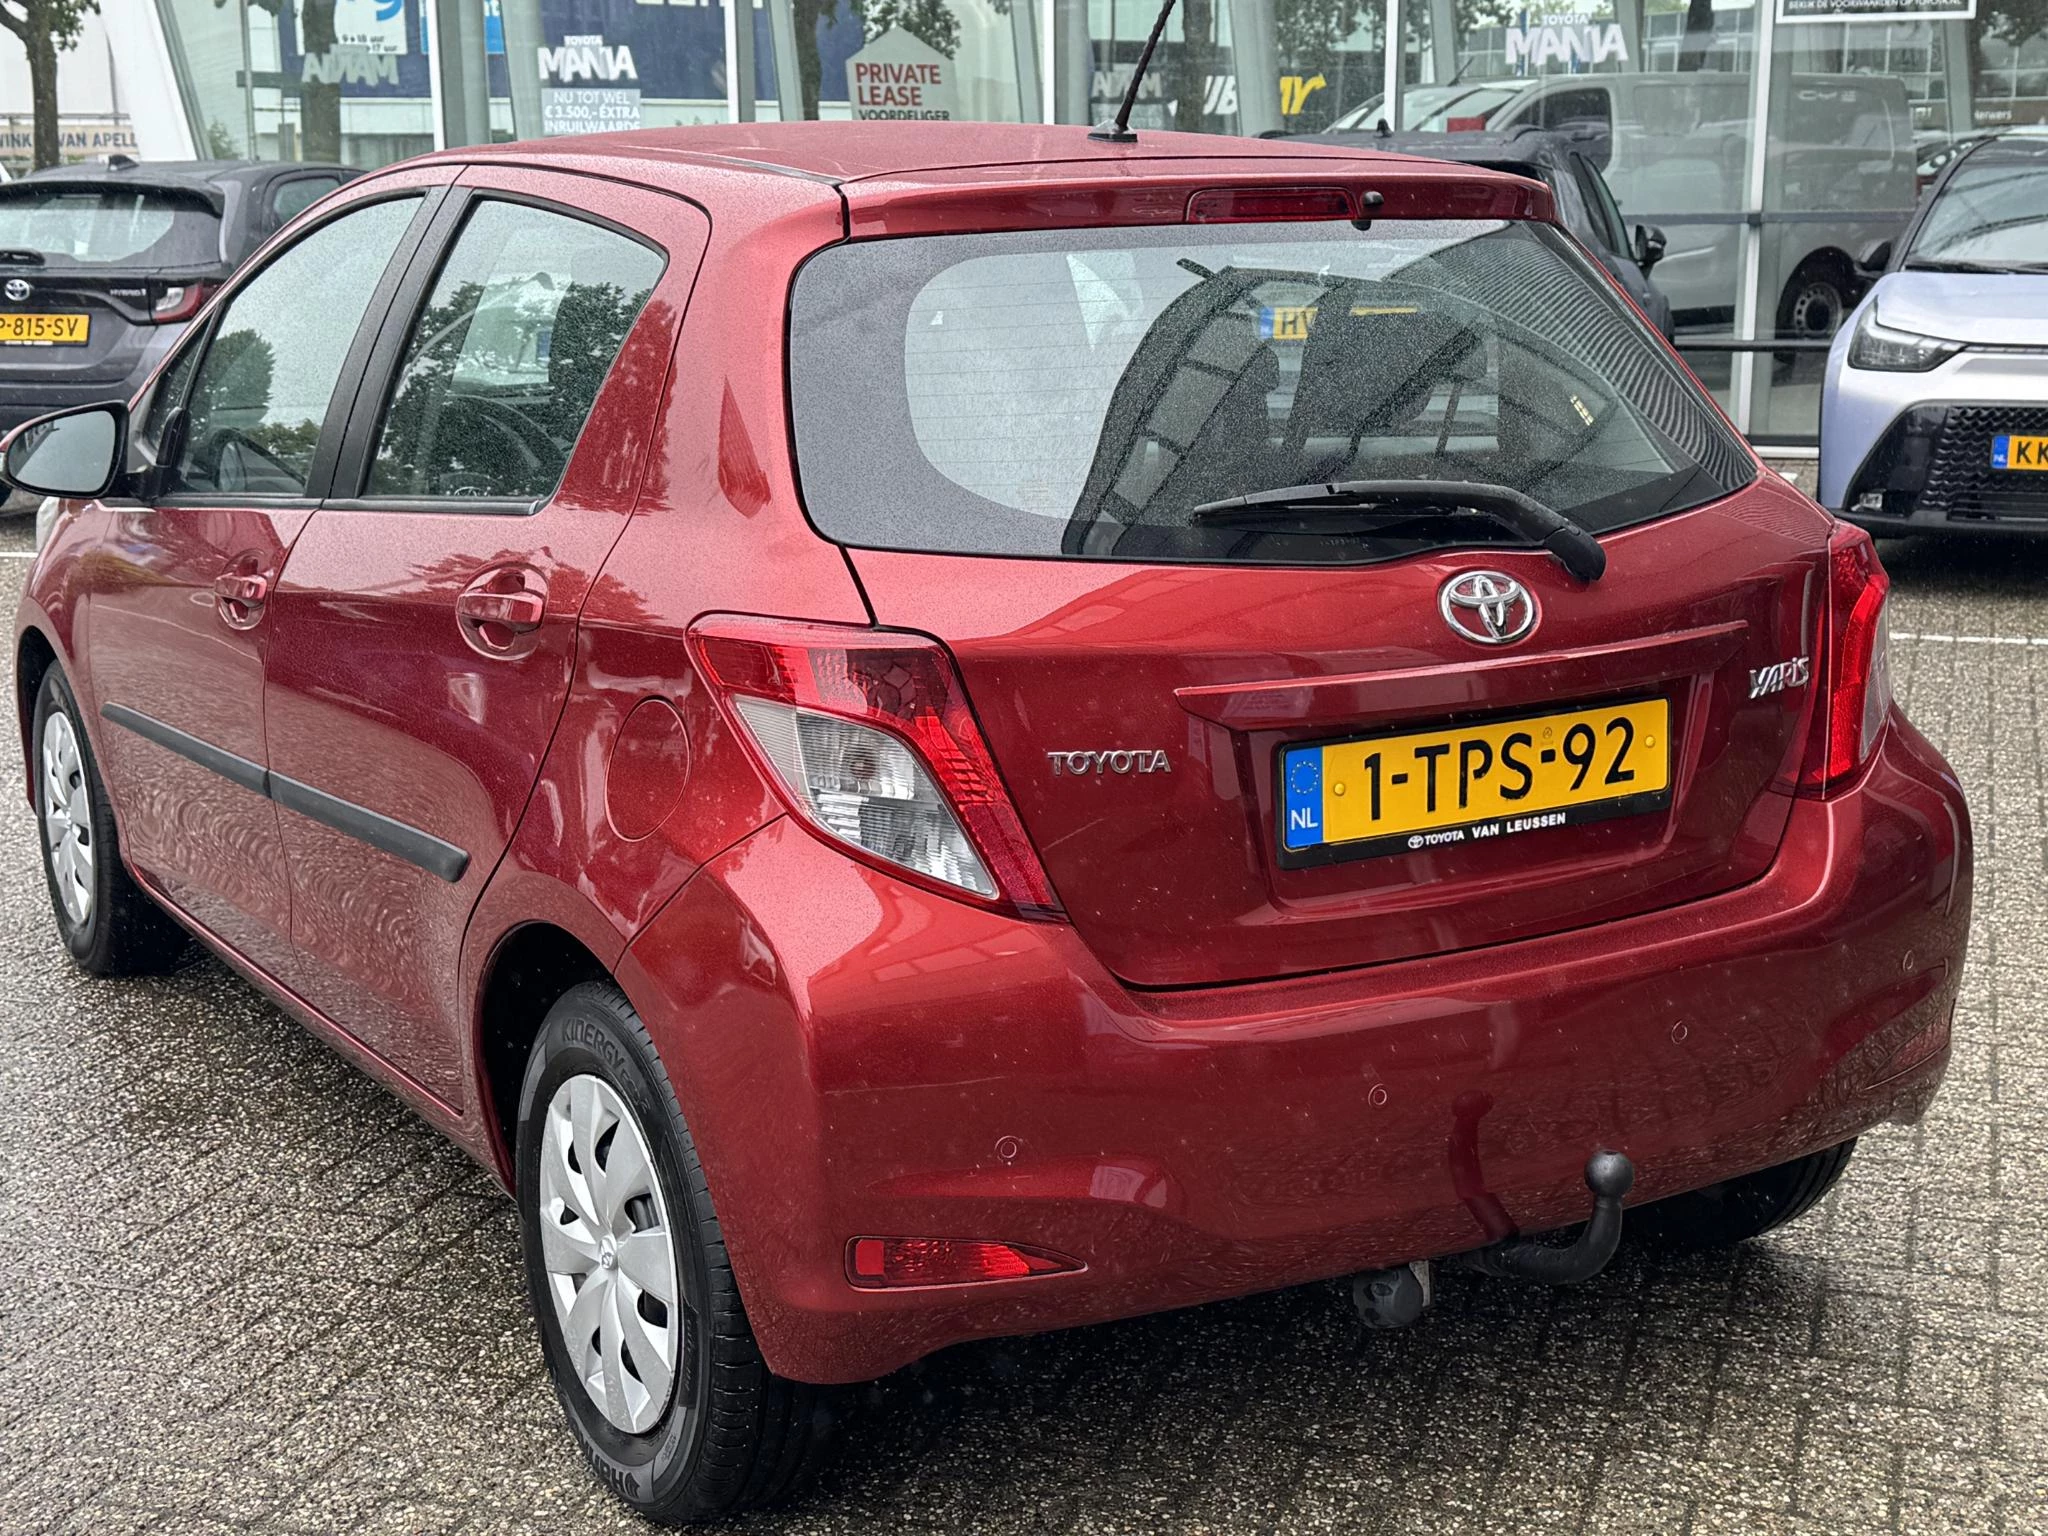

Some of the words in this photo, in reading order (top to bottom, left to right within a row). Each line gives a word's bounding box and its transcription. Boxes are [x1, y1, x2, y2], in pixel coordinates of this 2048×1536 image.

[1543, 14, 1589, 25] TOYOTA
[1505, 23, 1628, 66] MANIA
[537, 45, 639, 83] MANIA
[855, 62, 942, 85] PRIVATE
[553, 91, 574, 104] NU
[577, 91, 599, 104] TOT
[602, 91, 631, 105] WEL
[857, 85, 923, 106] LEASE
[1748, 656, 1809, 699] YARIS
[1047, 750, 1172, 775] TOYOTA
[1363, 716, 1636, 822] 1-TPS-92
[1291, 807, 1319, 831] NL
[1424, 829, 1465, 845] TOYOTA
[1472, 823, 1500, 839] VAN
[1506, 812, 1567, 833] LEUSSEN
